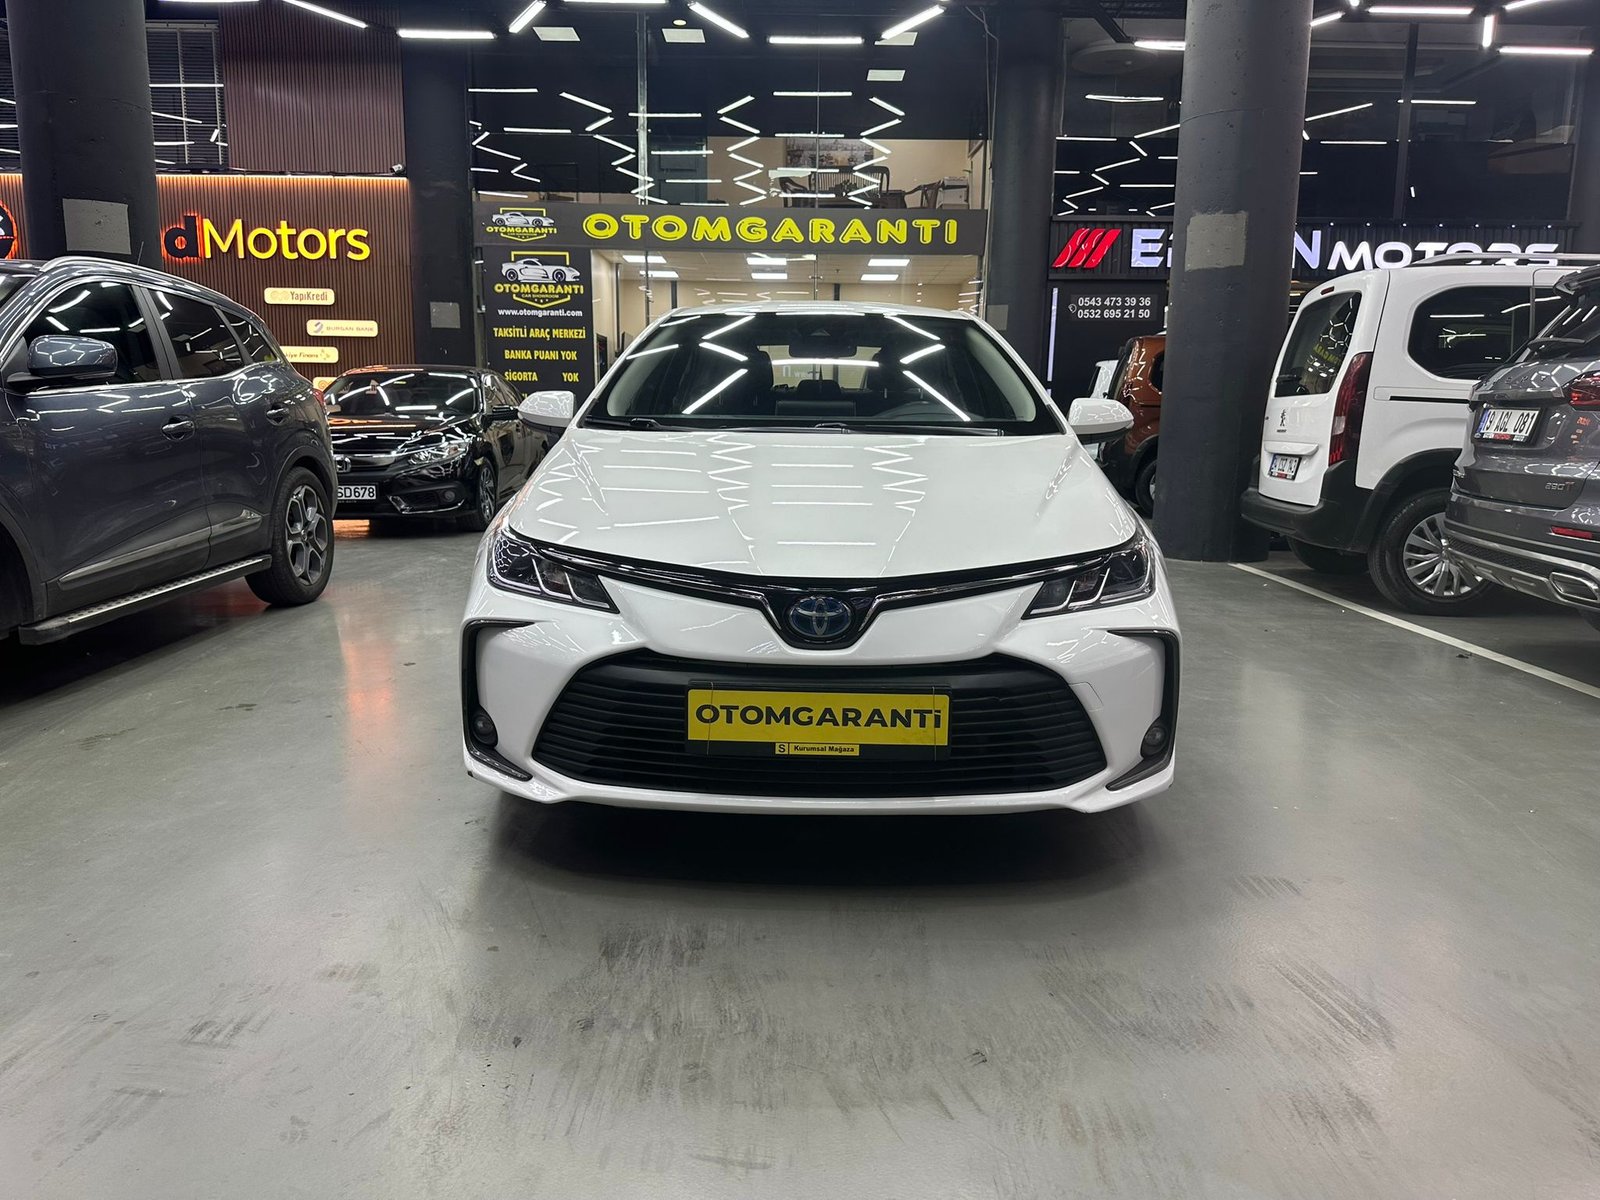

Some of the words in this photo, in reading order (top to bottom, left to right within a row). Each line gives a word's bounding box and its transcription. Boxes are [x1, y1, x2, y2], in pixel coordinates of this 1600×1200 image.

[486, 226, 557, 234] OTOMGARANTI
[582, 213, 959, 245] OTOMGARANTI
[494, 283, 584, 295] OTOMGARANTI
[1078, 297, 1102, 306] 0543
[1104, 297, 1122, 306] 473
[1124, 297, 1136, 306] 39
[1139, 297, 1151, 306] 36
[498, 309, 583, 317] www.otomgaranti.com
[1077, 309, 1101, 318] 0532
[1103, 309, 1121, 318] 695
[1123, 309, 1135, 318] 21
[1138, 309, 1150, 318] 50
[493, 326, 527, 338] TAKSİTLİ
[529, 328, 551, 340] ARAÇ
[552, 327, 586, 339] MERKEZİ
[504, 350, 532, 360] BANKA
[534, 350, 559, 360] PUANI
[560, 351, 577, 360] YOK
[504, 370, 538, 381] SİGORTA
[562, 372, 579, 382] YOK
[1512, 412, 1536, 434] 081
[778, 744, 786, 753] S
[793, 744, 827, 753] Kurumsal
[828, 745, 855, 754] Mağaza
